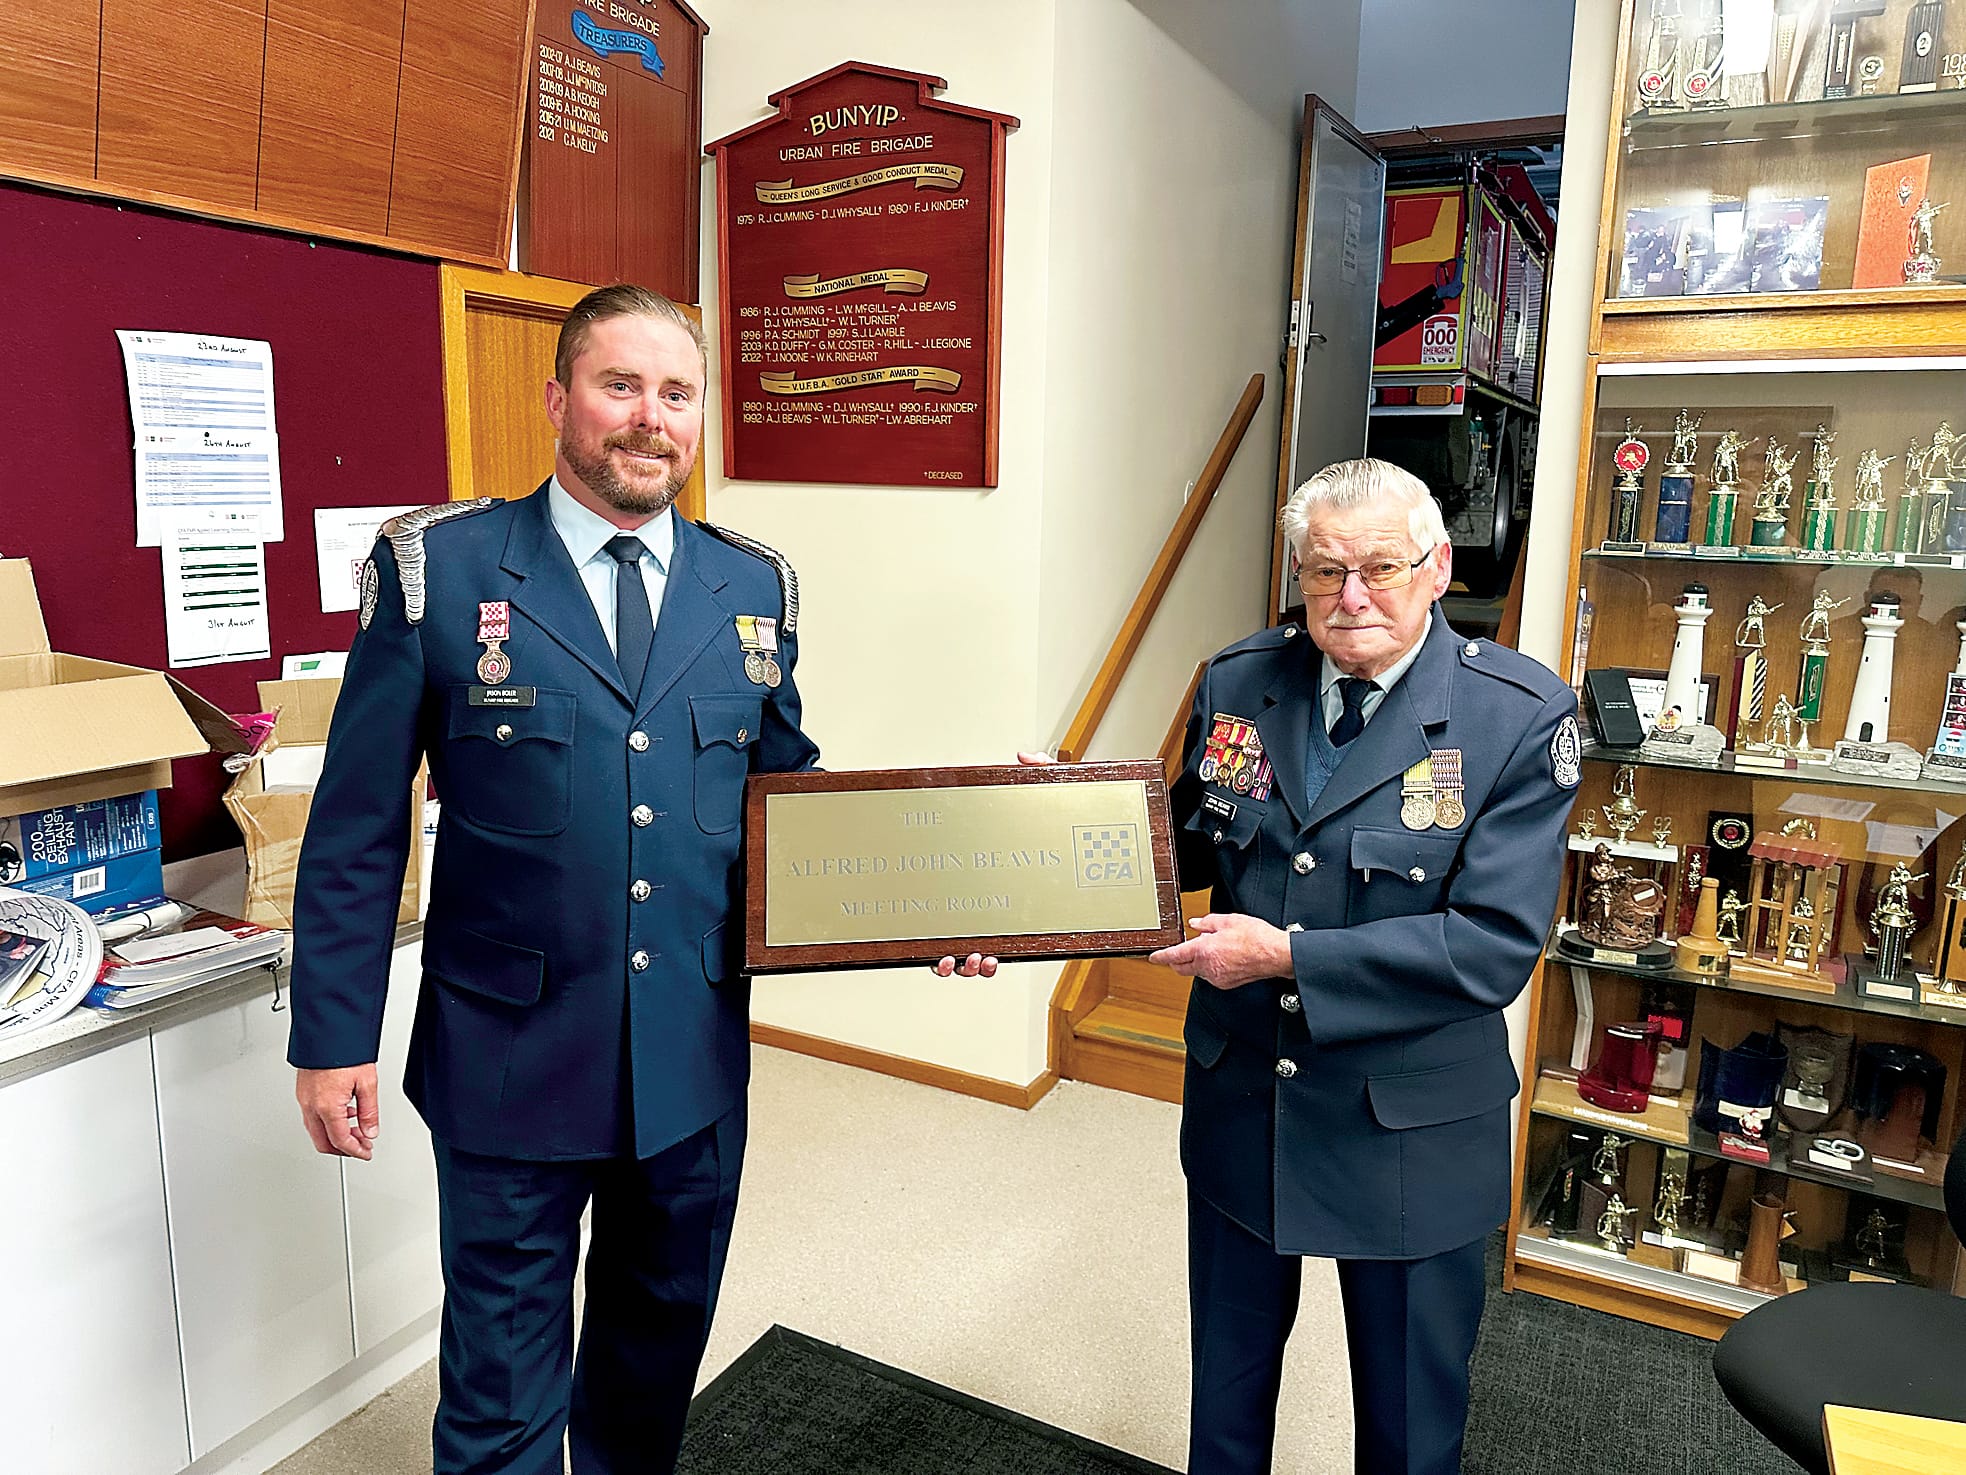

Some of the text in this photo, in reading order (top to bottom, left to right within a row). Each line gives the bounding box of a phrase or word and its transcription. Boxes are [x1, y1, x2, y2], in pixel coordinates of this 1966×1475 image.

[610, 2, 660, 37] BRIGADE
[579, 24, 648, 51] TREASURERS
[1919, 37, 1927, 50] 2
[780, 135, 934, 161] URBAN FIRE BRIGADE
[770, 165, 949, 200] QUEEN'S LONG SERVICE & GOOD CONDUCT MEDAL
[814, 272, 890, 293] NATIONAL MEDAL
[1424, 328, 1457, 345] 000
[889, 368, 919, 378] AWARD
[902, 811, 943, 826] THE
[43, 813, 58, 863] CEILING
[53, 809, 69, 865] EXHAUST
[65, 821, 77, 847] FAN
[786, 849, 1061, 877] ALFRED JOHN BEAVIS
[1085, 861, 1134, 881] CFA
[841, 895, 1010, 917] MEETING ROOM
[58, 970, 78, 994] CFA
